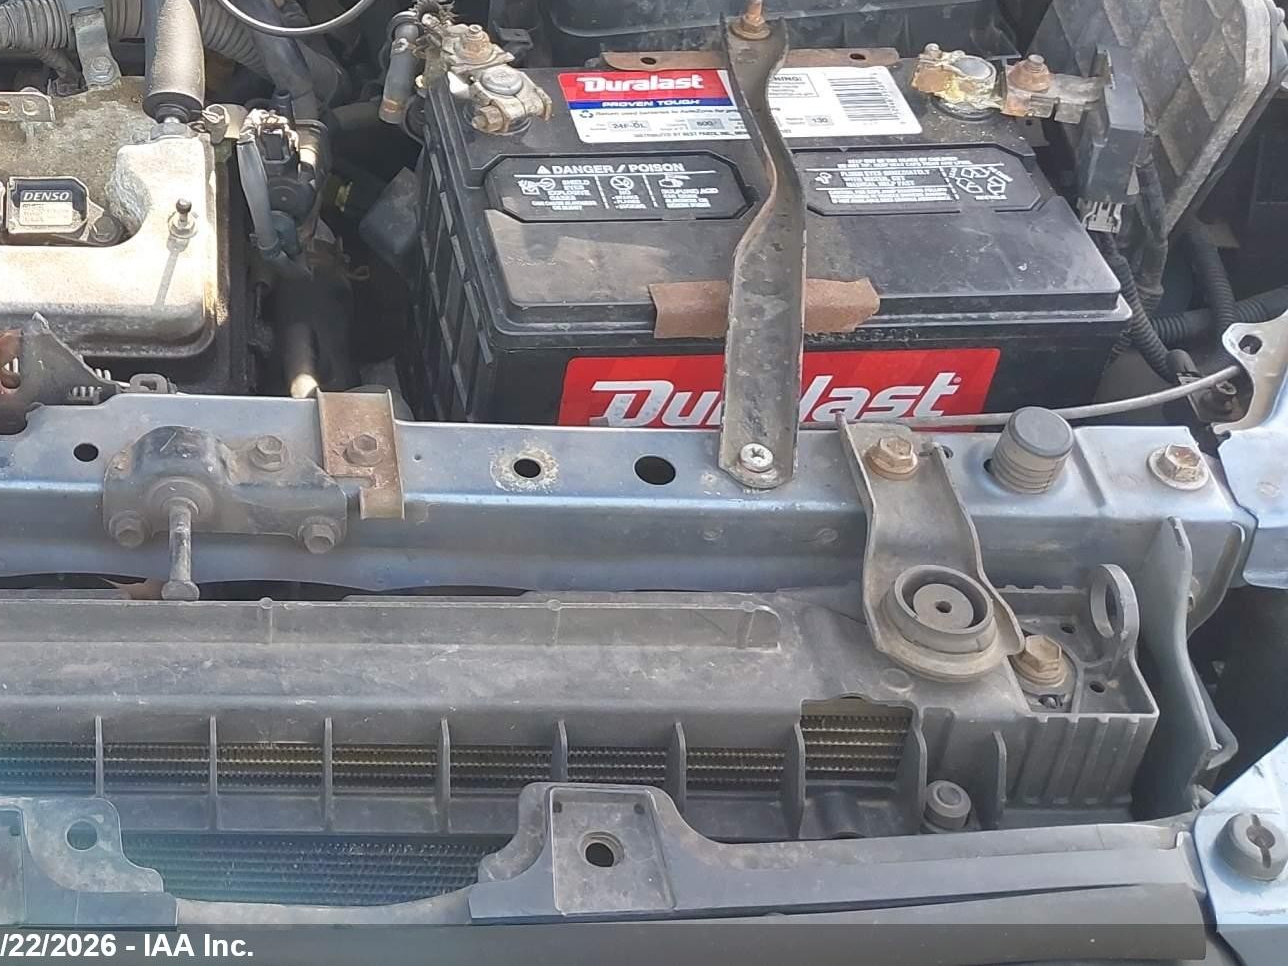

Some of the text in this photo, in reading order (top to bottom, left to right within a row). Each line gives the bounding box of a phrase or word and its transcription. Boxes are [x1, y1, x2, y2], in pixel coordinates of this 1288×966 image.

[577, 74, 704, 92] Duralast
[552, 165, 614, 174] DANGER
[629, 163, 685, 172] POISON
[23, 192, 70, 201] DENSO
[591, 372, 960, 426] Dulast
